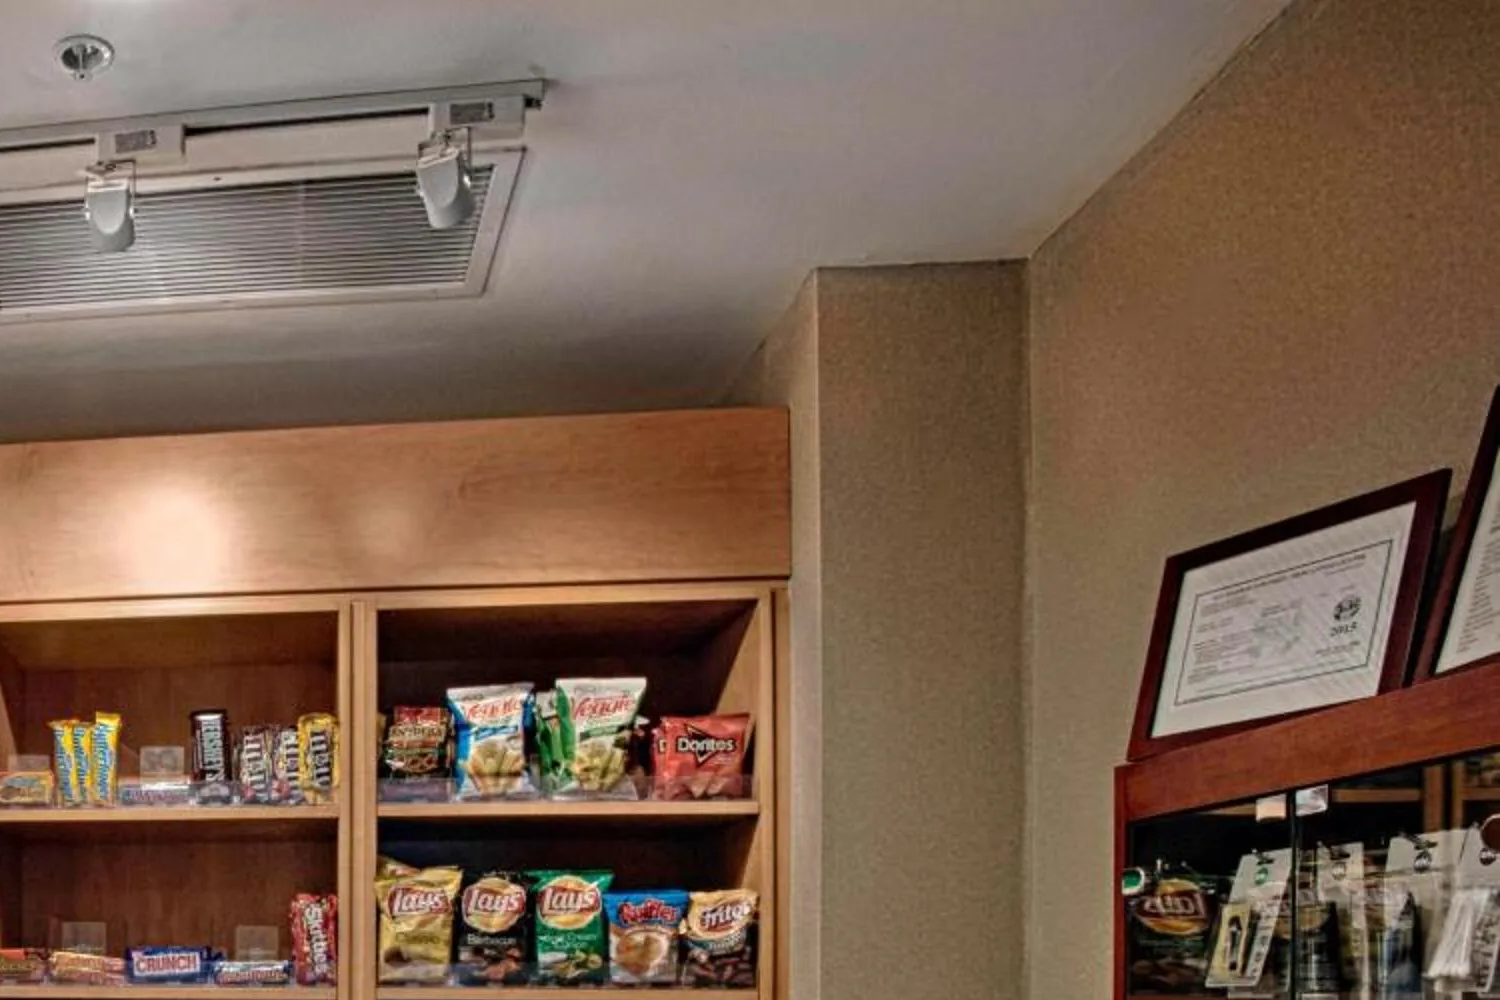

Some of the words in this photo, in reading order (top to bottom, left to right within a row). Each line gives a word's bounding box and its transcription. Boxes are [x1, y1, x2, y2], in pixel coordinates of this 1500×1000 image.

[678, 737, 734, 752] Doritos
[304, 903, 332, 976] Skittles
[136, 955, 196, 973] CRUNCH
